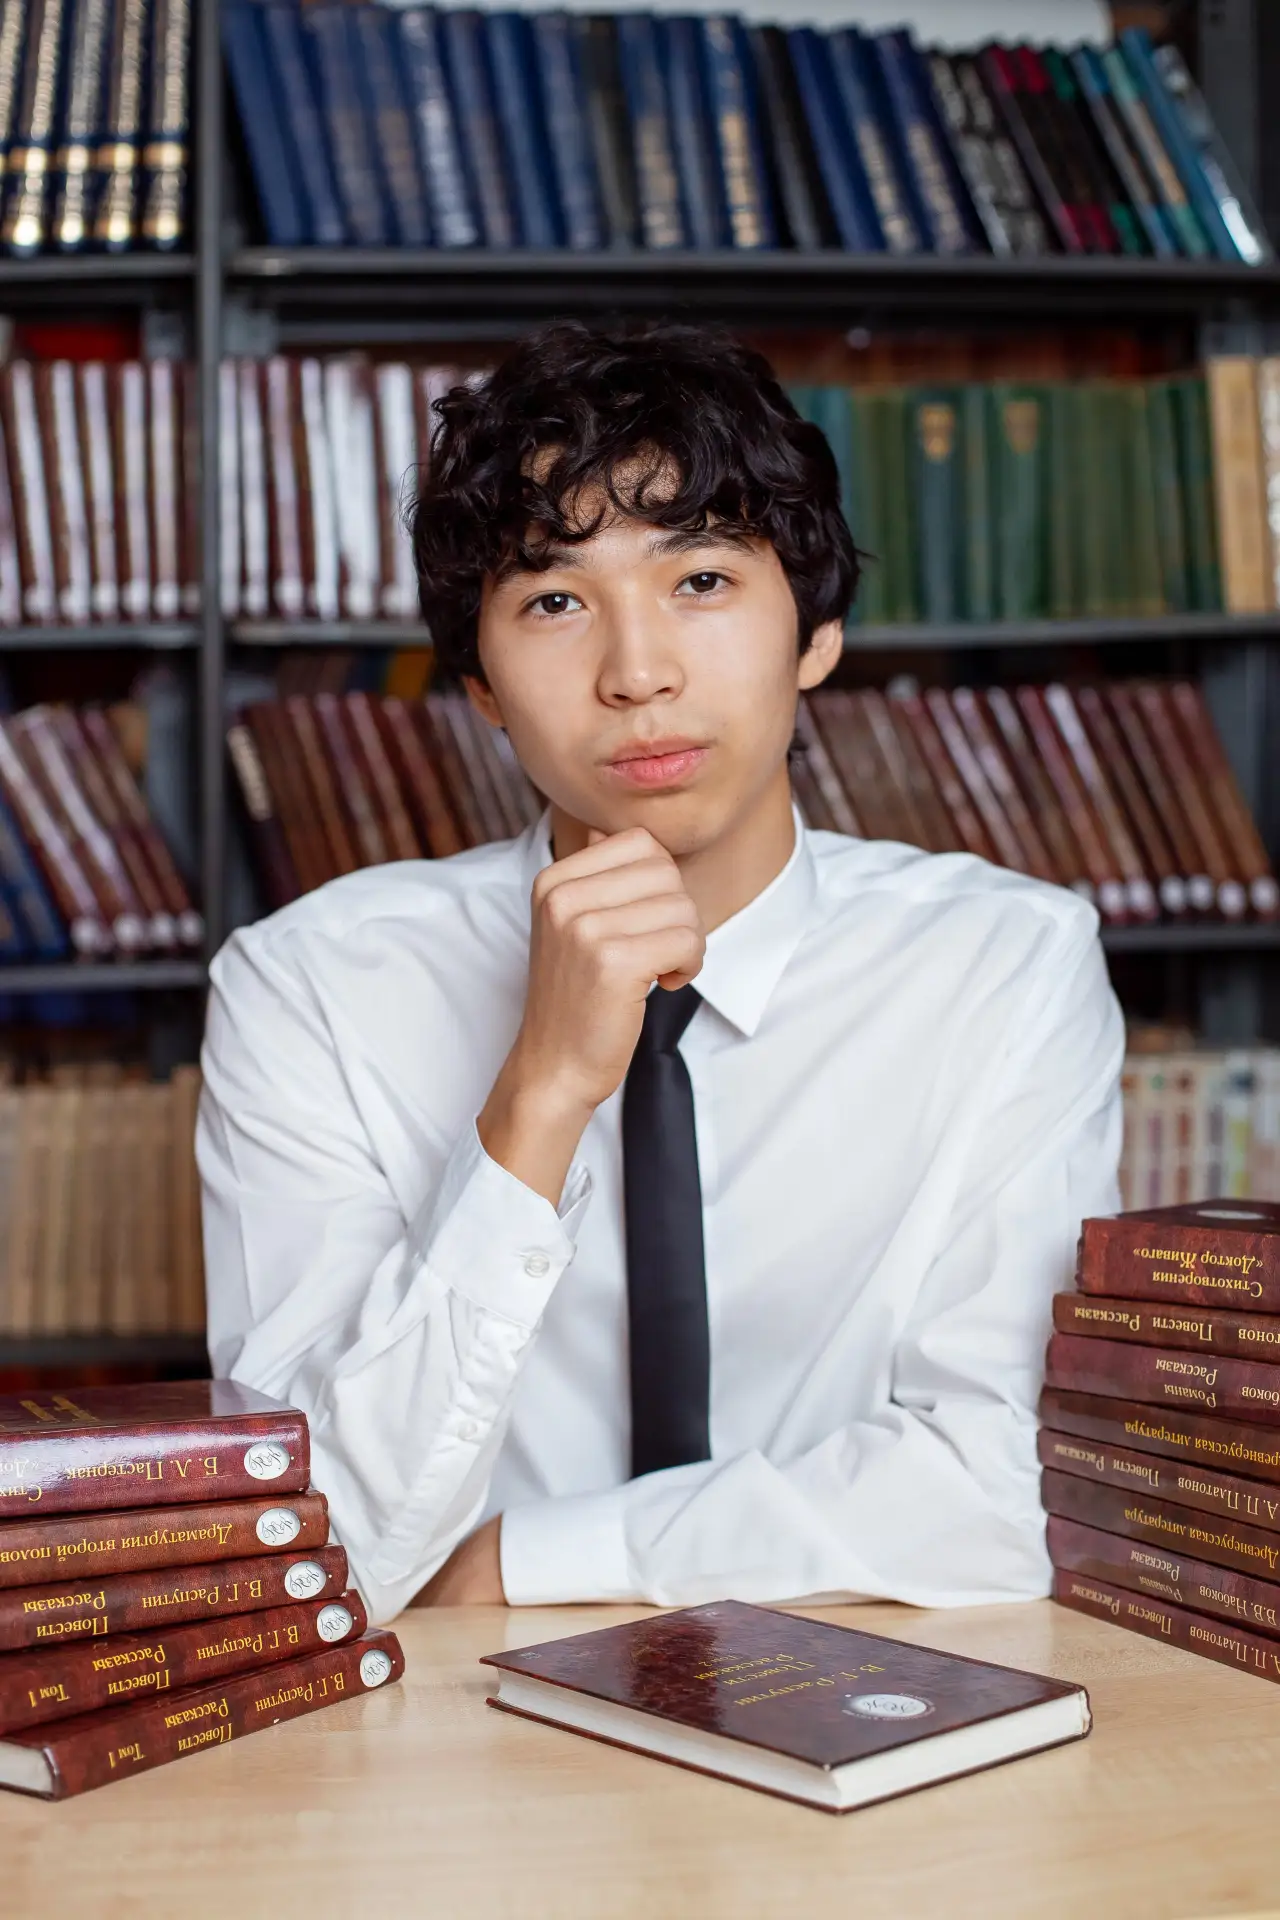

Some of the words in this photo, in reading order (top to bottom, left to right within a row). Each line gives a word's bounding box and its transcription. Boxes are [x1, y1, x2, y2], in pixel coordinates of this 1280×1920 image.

[1134, 1247, 1197, 1269] Живаго»
[1201, 1251, 1263, 1274] «Доктор
[1153, 1271, 1263, 1297] Стихотворения
[1075, 1307, 1140, 1331] Рассказы
[1153, 1317, 1212, 1341] Повести
[1156, 1359, 1217, 1385] Рассказы
[1164, 1384, 1216, 1407] Романы
[1125, 1422, 1192, 1447] литература
[1055, 1444, 1104, 1471] Рассказы
[1195, 1437, 1280, 1466] ревнерусская
[65, 1461, 163, 1480] Пастернак
[170, 1460, 191, 1478] Л.
[199, 1456, 218, 1476] Б.
[1113, 1459, 1159, 1486] Повести
[1179, 1477, 1239, 1509] Платонов
[1244, 1494, 1258, 1515] П.
[1264, 1500, 1279, 1519] А.
[1125, 1508, 1186, 1537] литература
[122, 1523, 232, 1549] Драматургия
[57, 1539, 115, 1562] второй
[1190, 1529, 1278, 1569] Древнерусская
[1131, 1551, 1180, 1581] Рассказы
[142, 1587, 219, 1607] Распутин
[225, 1583, 239, 1601] Г.
[245, 1580, 262, 1597] В.
[1200, 1585, 1248, 1616] Набоков
[24, 1591, 105, 1613] Рассказы
[37, 1616, 108, 1637] Повести
[1129, 1605, 1171, 1634] Повести
[198, 1633, 263, 1660] Распутин
[267, 1630, 279, 1648] Г.
[283, 1625, 299, 1644] В.
[1190, 1626, 1247, 1662] Платонов
[93, 1645, 166, 1670] Рассказы
[693, 1653, 794, 1680] Рассказы
[852, 1663, 886, 1673] В.
[1251, 1648, 1266, 1669] П.
[108, 1669, 169, 1695] Повести
[330, 1672, 344, 1690] В.
[722, 1661, 816, 1686] Повести
[40, 1684, 69, 1701] Том
[256, 1681, 313, 1712] Распутин
[315, 1677, 328, 1696] Г.
[733, 1678, 835, 1706] Распутин
[164, 1699, 229, 1728] Рассказы
[178, 1723, 232, 1751] Повести
[119, 1743, 146, 1761] Том
